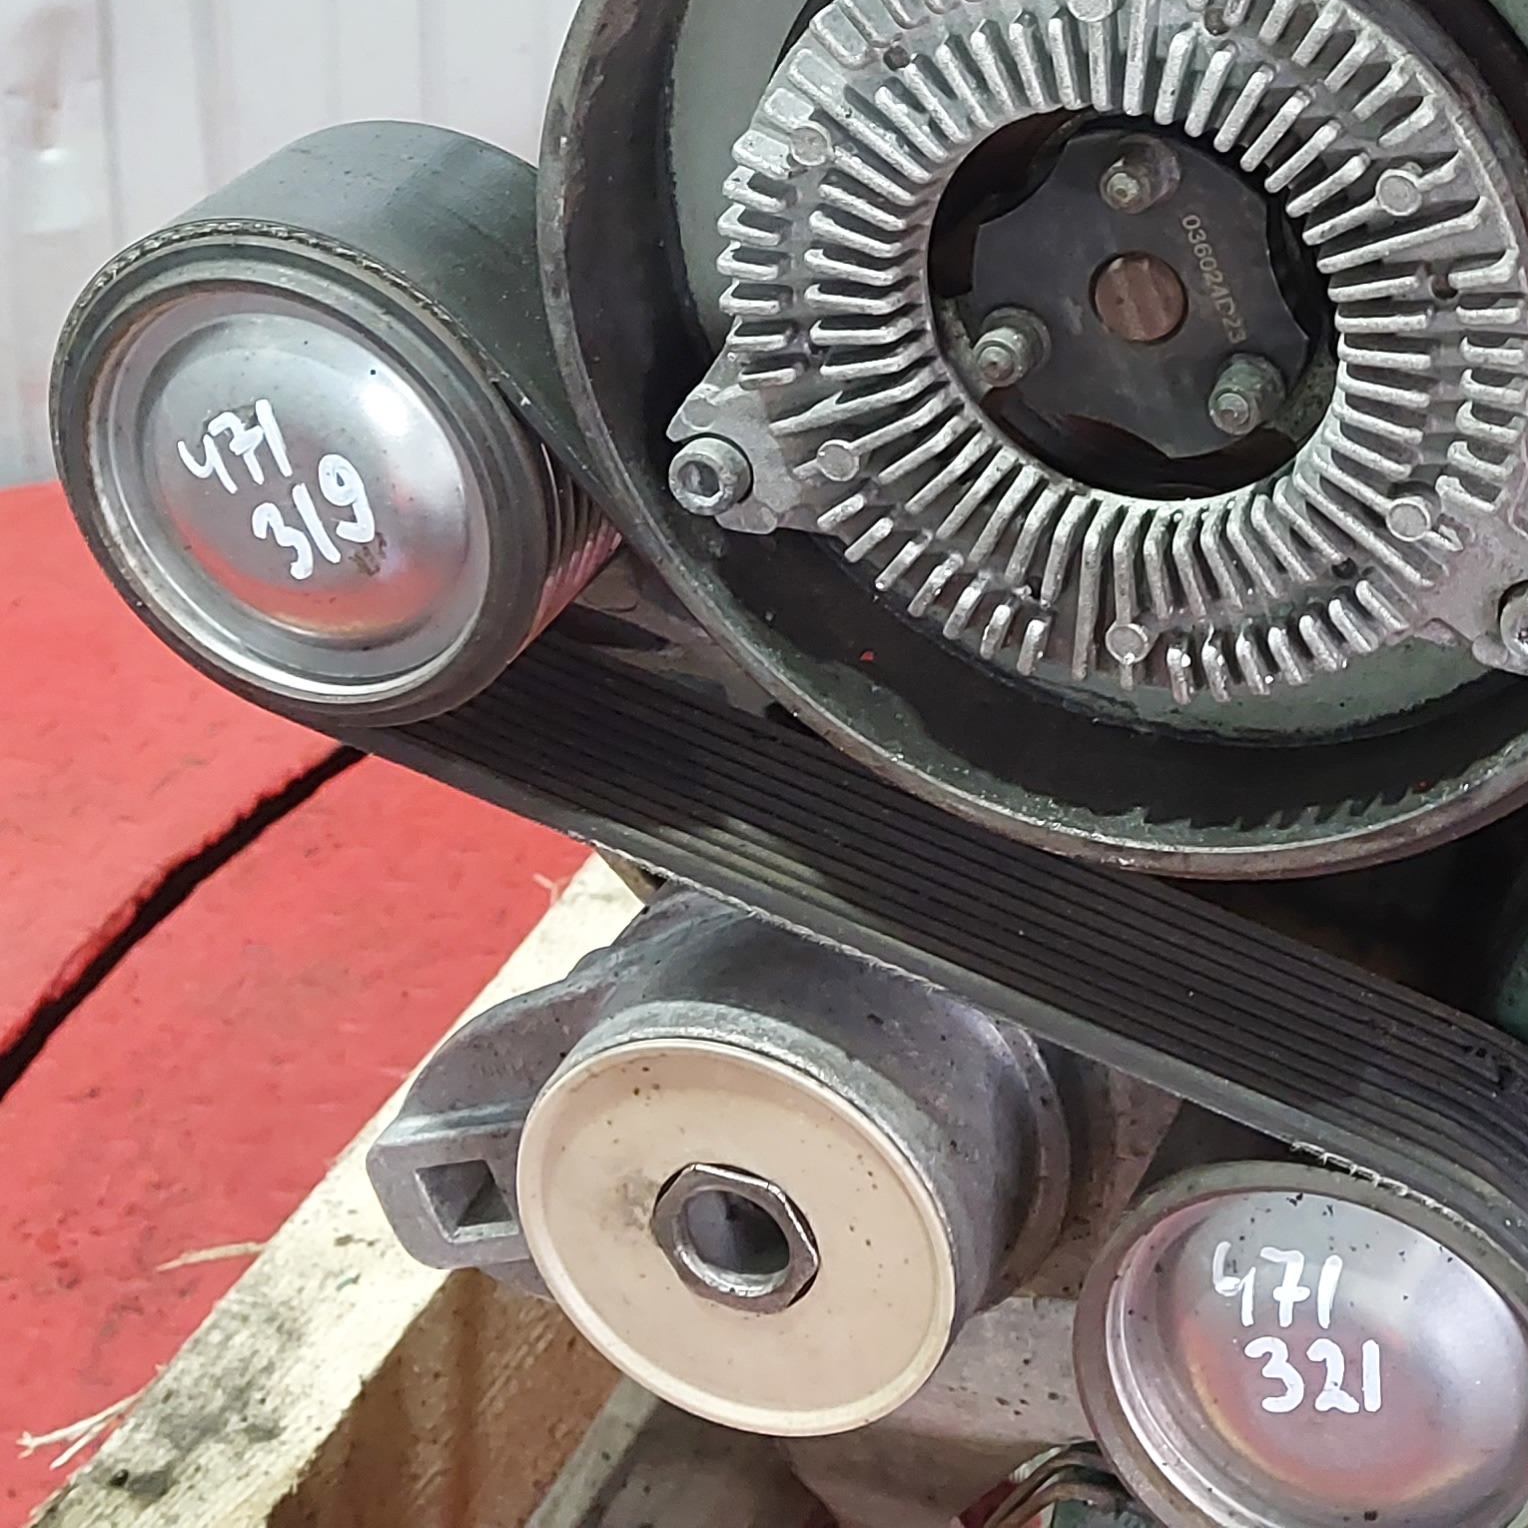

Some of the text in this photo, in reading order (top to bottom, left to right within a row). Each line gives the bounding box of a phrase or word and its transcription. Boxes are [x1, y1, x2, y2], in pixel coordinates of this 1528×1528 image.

[177, 398, 293, 495] 471
[251, 453, 376, 580] 319
[1212, 1240, 1344, 1330] 471
[1244, 1335, 1383, 1414] 321
